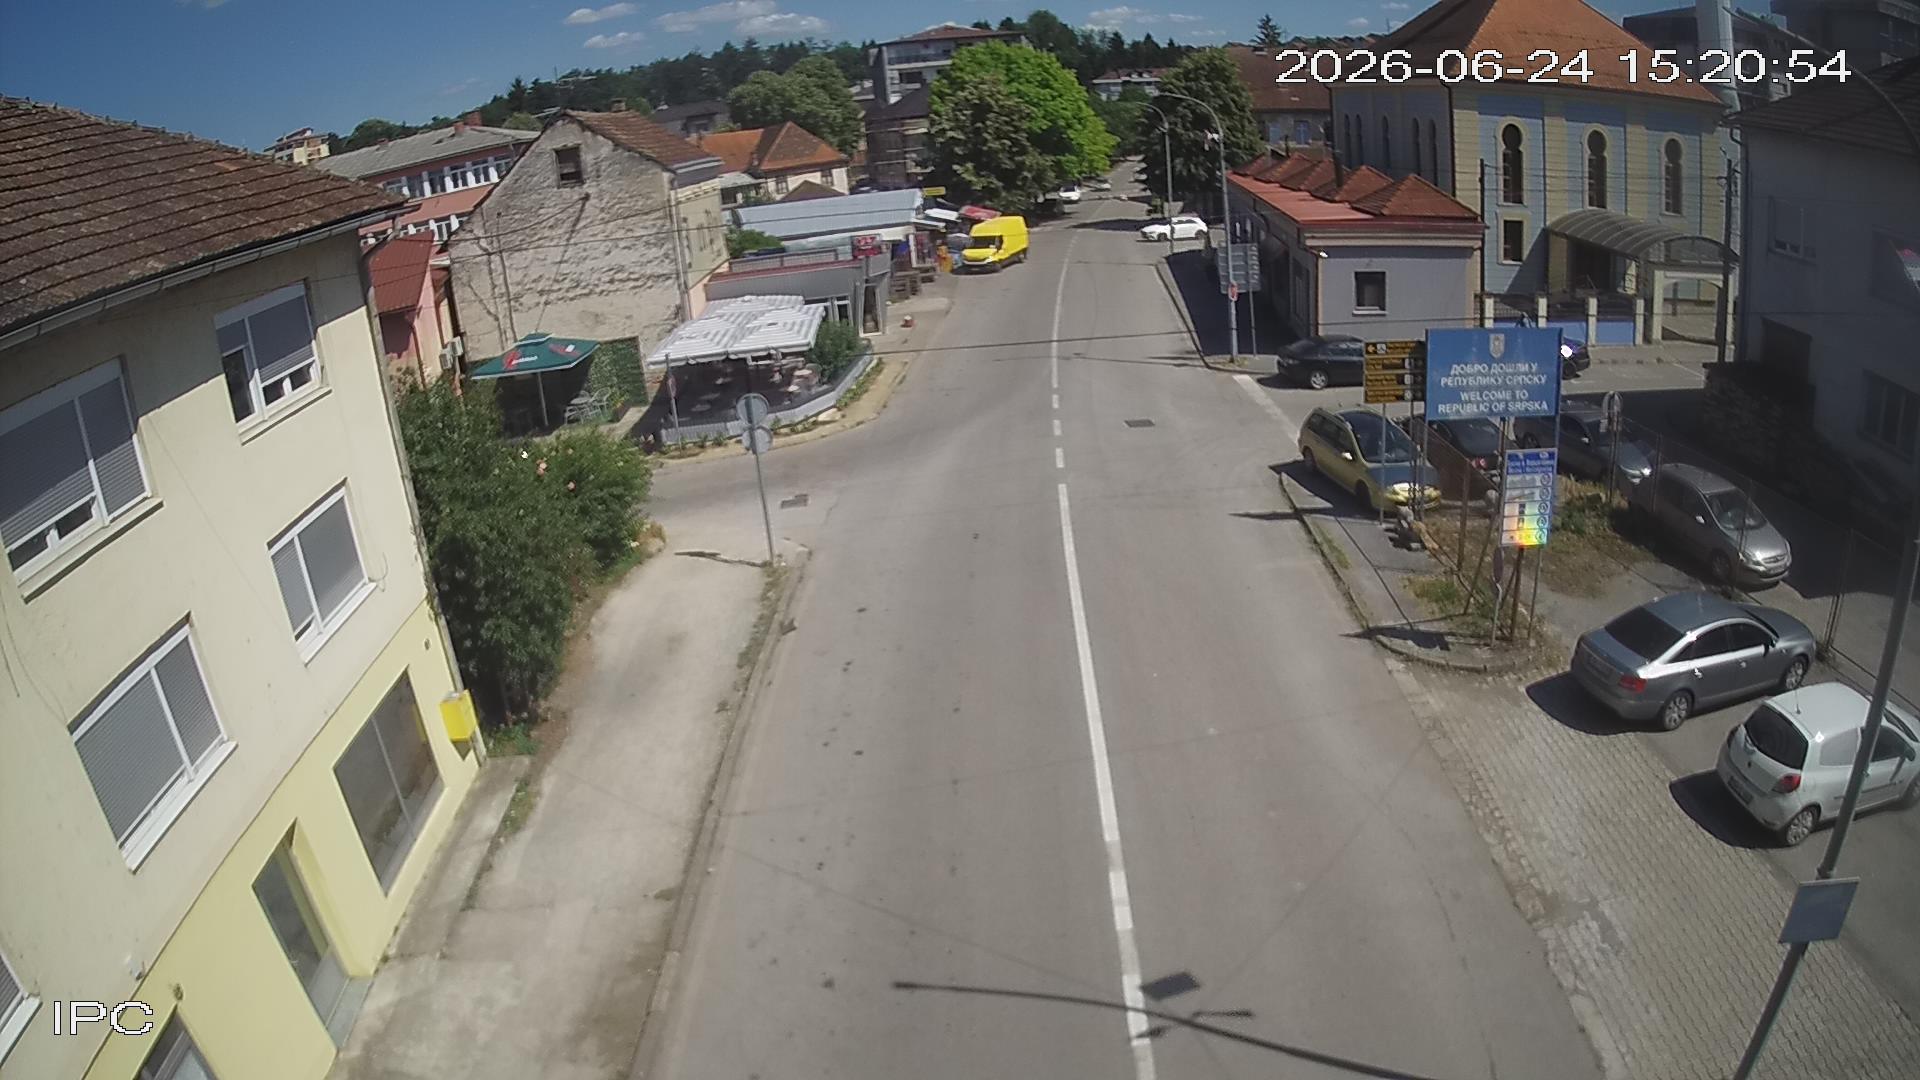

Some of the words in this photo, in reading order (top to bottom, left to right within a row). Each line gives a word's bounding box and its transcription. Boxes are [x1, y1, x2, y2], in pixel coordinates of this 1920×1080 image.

[1451, 363, 1489, 376] ДОБРО
[1491, 362, 1529, 375] ДОШЛИ
[1530, 362, 1538, 373] У
[1440, 376, 1504, 388] РЕПУБЛИКУ
[1506, 374, 1547, 385] СРПСКУ
[1460, 390, 1512, 401] WELCOME
[1515, 389, 1529, 400] TO
[1438, 403, 1490, 415] REPUBLIC
[1491, 402, 1506, 413] OF
[1507, 400, 1548, 412] SRPSKA
